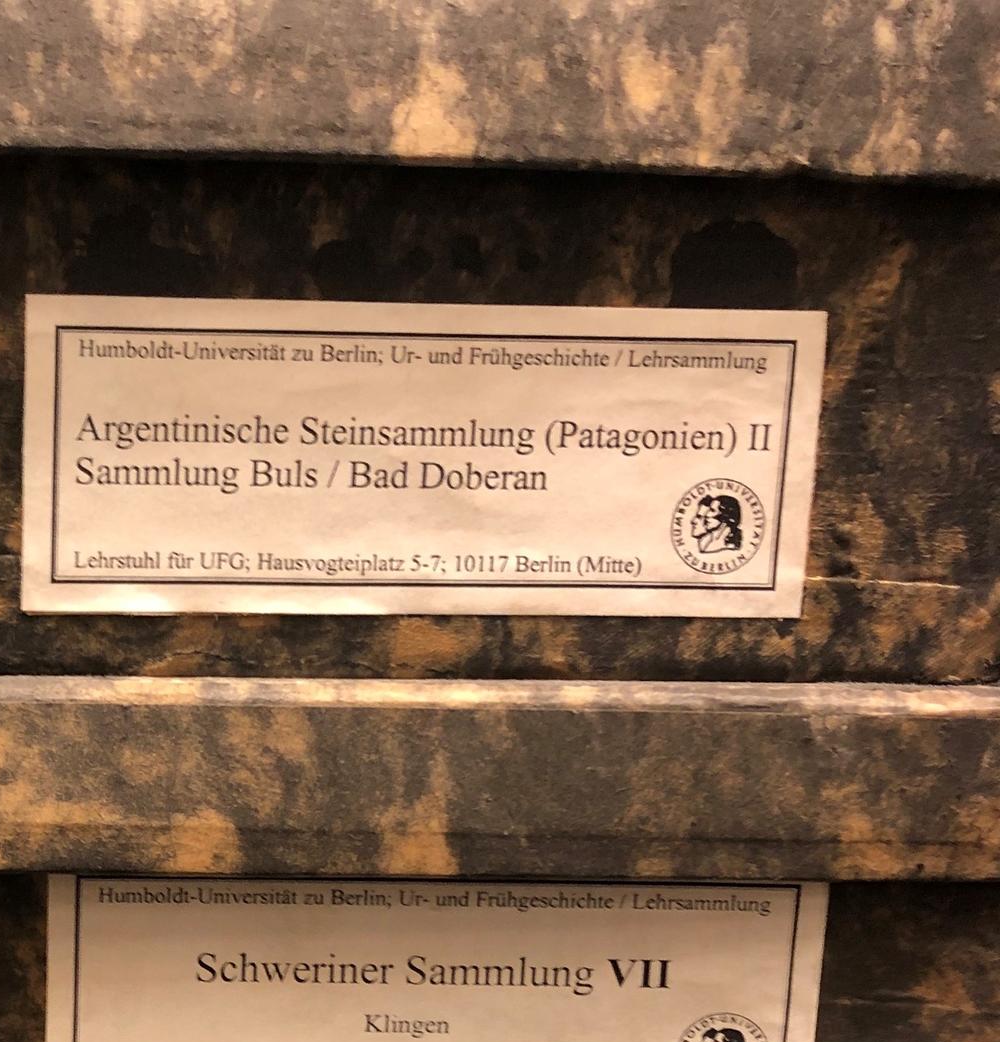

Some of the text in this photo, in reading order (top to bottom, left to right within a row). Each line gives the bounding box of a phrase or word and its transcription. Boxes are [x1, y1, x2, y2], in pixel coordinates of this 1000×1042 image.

[78, 338, 768, 375] Humboldt-Universität zu Berlin; Ur- und Frühgeschichte / Lehrsammlung
[76, 413, 772, 457] Argentinische Steinsammlung (Patagonien) II
[75, 456, 548, 495] Sammlung Buls / Bad Doberan
[73, 550, 643, 578] Lehrstuhl für UFG; Hausvogteiplatz 5-7; 10117 Berlin (Mitte)
[98, 884, 772, 917] Humboldt-Universität zu Berlin; Ur- und Frühgeschichte / Lehrsammlung
[196, 952, 672, 997] Schweriner Sammlung VII
[364, 1013, 450, 1039] Klingen
